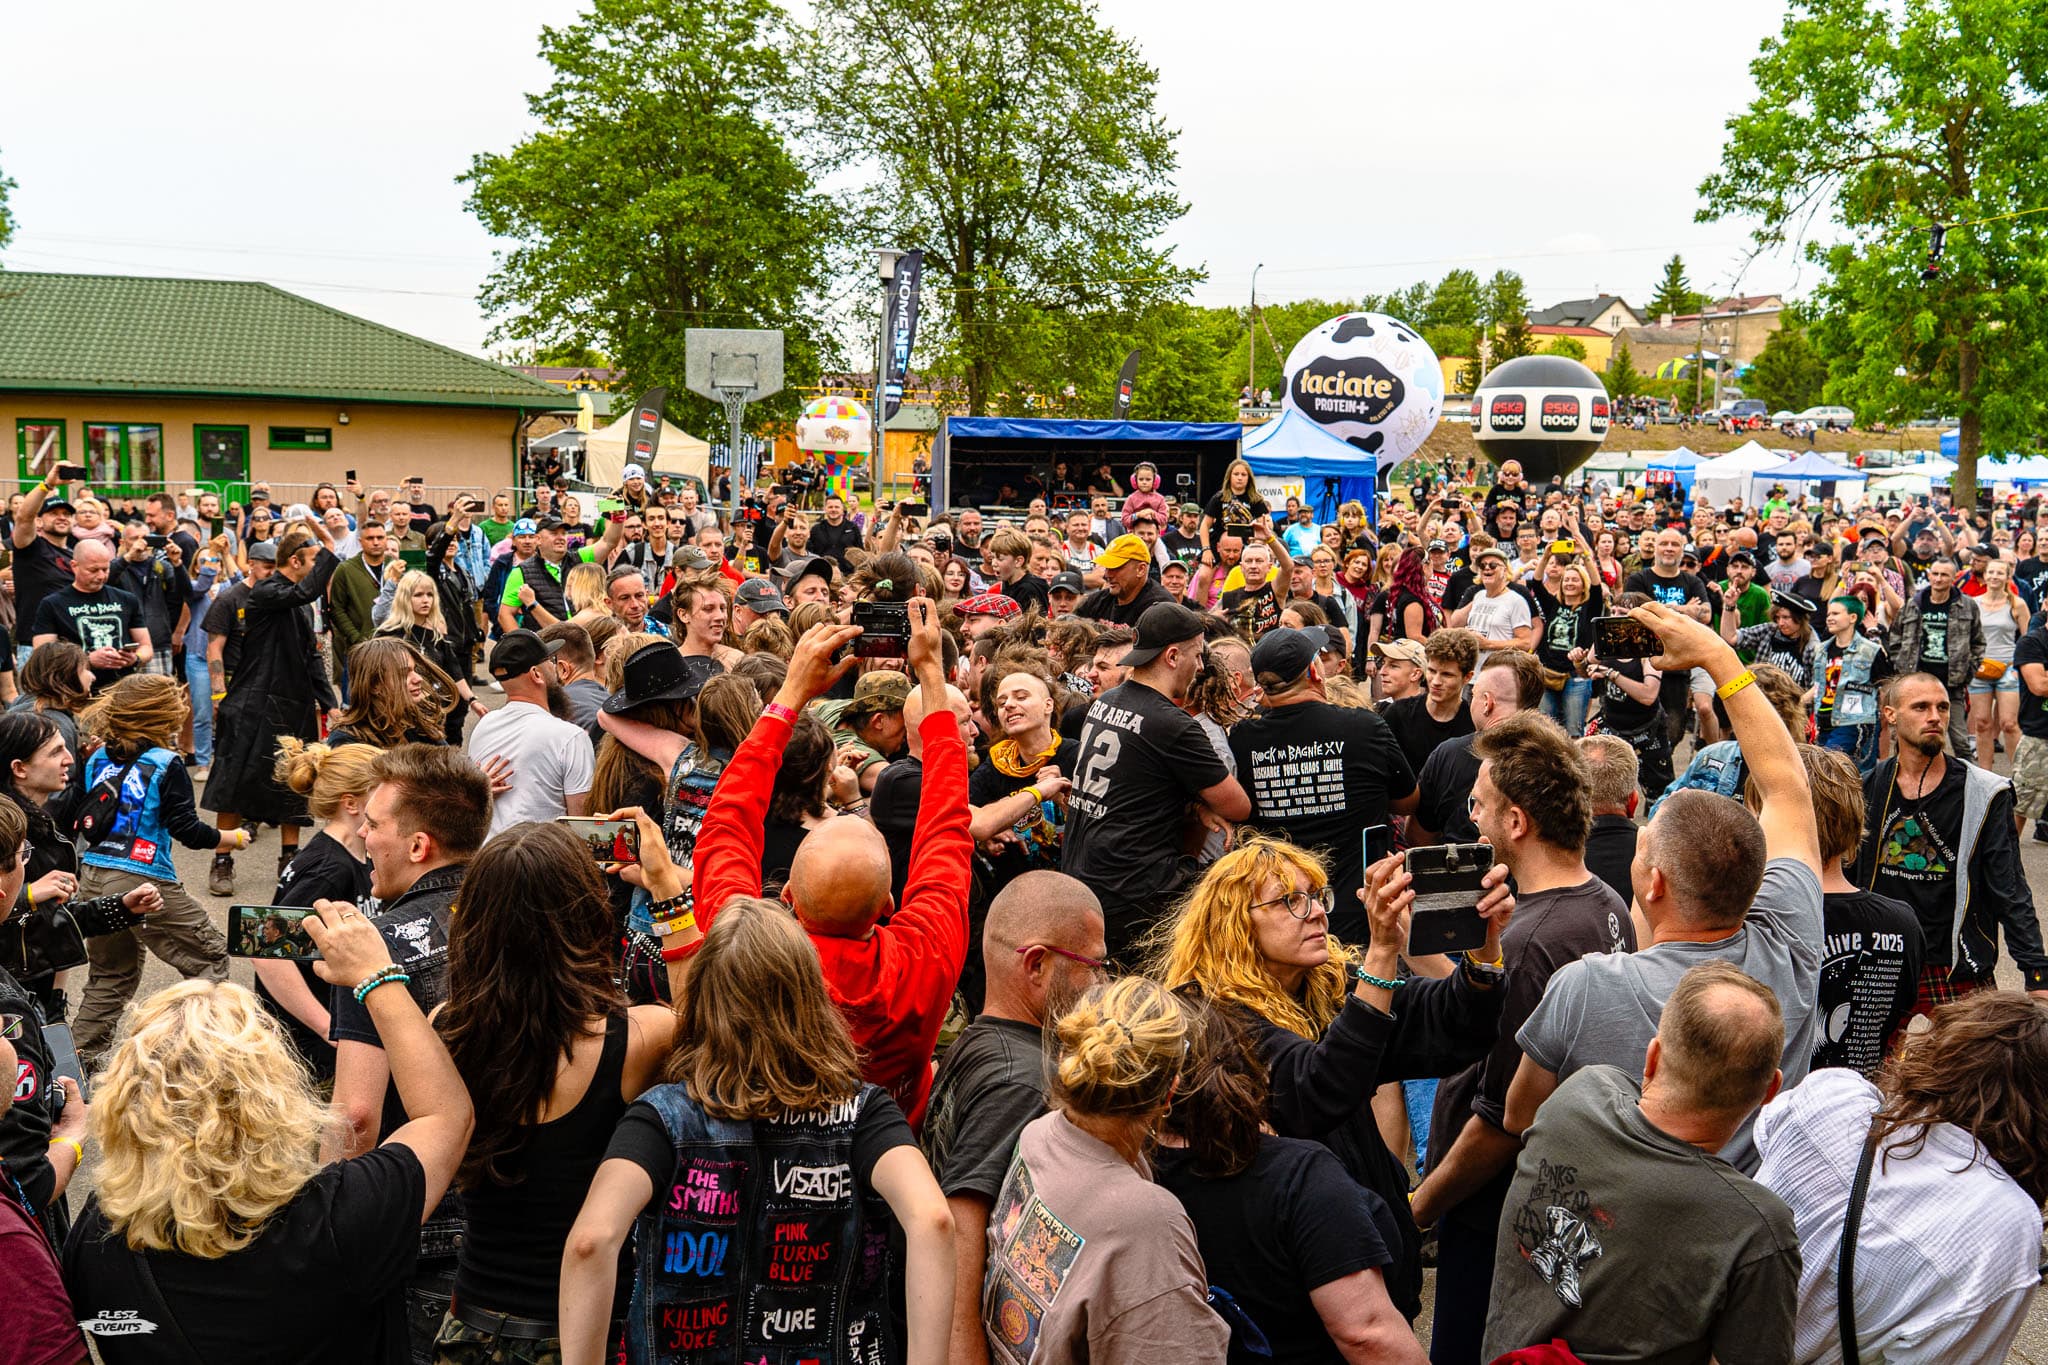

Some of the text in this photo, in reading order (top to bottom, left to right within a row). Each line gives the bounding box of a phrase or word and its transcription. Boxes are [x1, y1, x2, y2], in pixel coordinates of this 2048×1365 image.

[896, 270, 912, 374] HOMENET
[1492, 414, 1524, 426] ROCK
[1542, 414, 1578, 426] ROCK
[1103, 707, 1144, 735] AREA
[1071, 722, 1121, 799] 12
[1251, 746, 1277, 767] ROCK
[1324, 741, 1344, 755] XV
[1300, 761, 1320, 775] CHAOS
[1323, 758, 1343, 772] IGNITE
[1871, 931, 1904, 952] 2025
[687, 1168, 719, 1189] THE
[774, 1158, 851, 1200] VISAGE
[1538, 1158, 1578, 1188] PUNKS
[669, 1184, 739, 1215] SMITHS
[775, 1223, 808, 1242] PINK
[1034, 1202, 1079, 1249] OFFSPRING
[664, 1231, 729, 1277] IDOL
[771, 1242, 831, 1263] TURNS
[768, 1262, 813, 1283] BLUE
[663, 1301, 728, 1330] KILLING
[762, 1308, 816, 1340] CURE
[670, 1329, 717, 1349] JOKE
